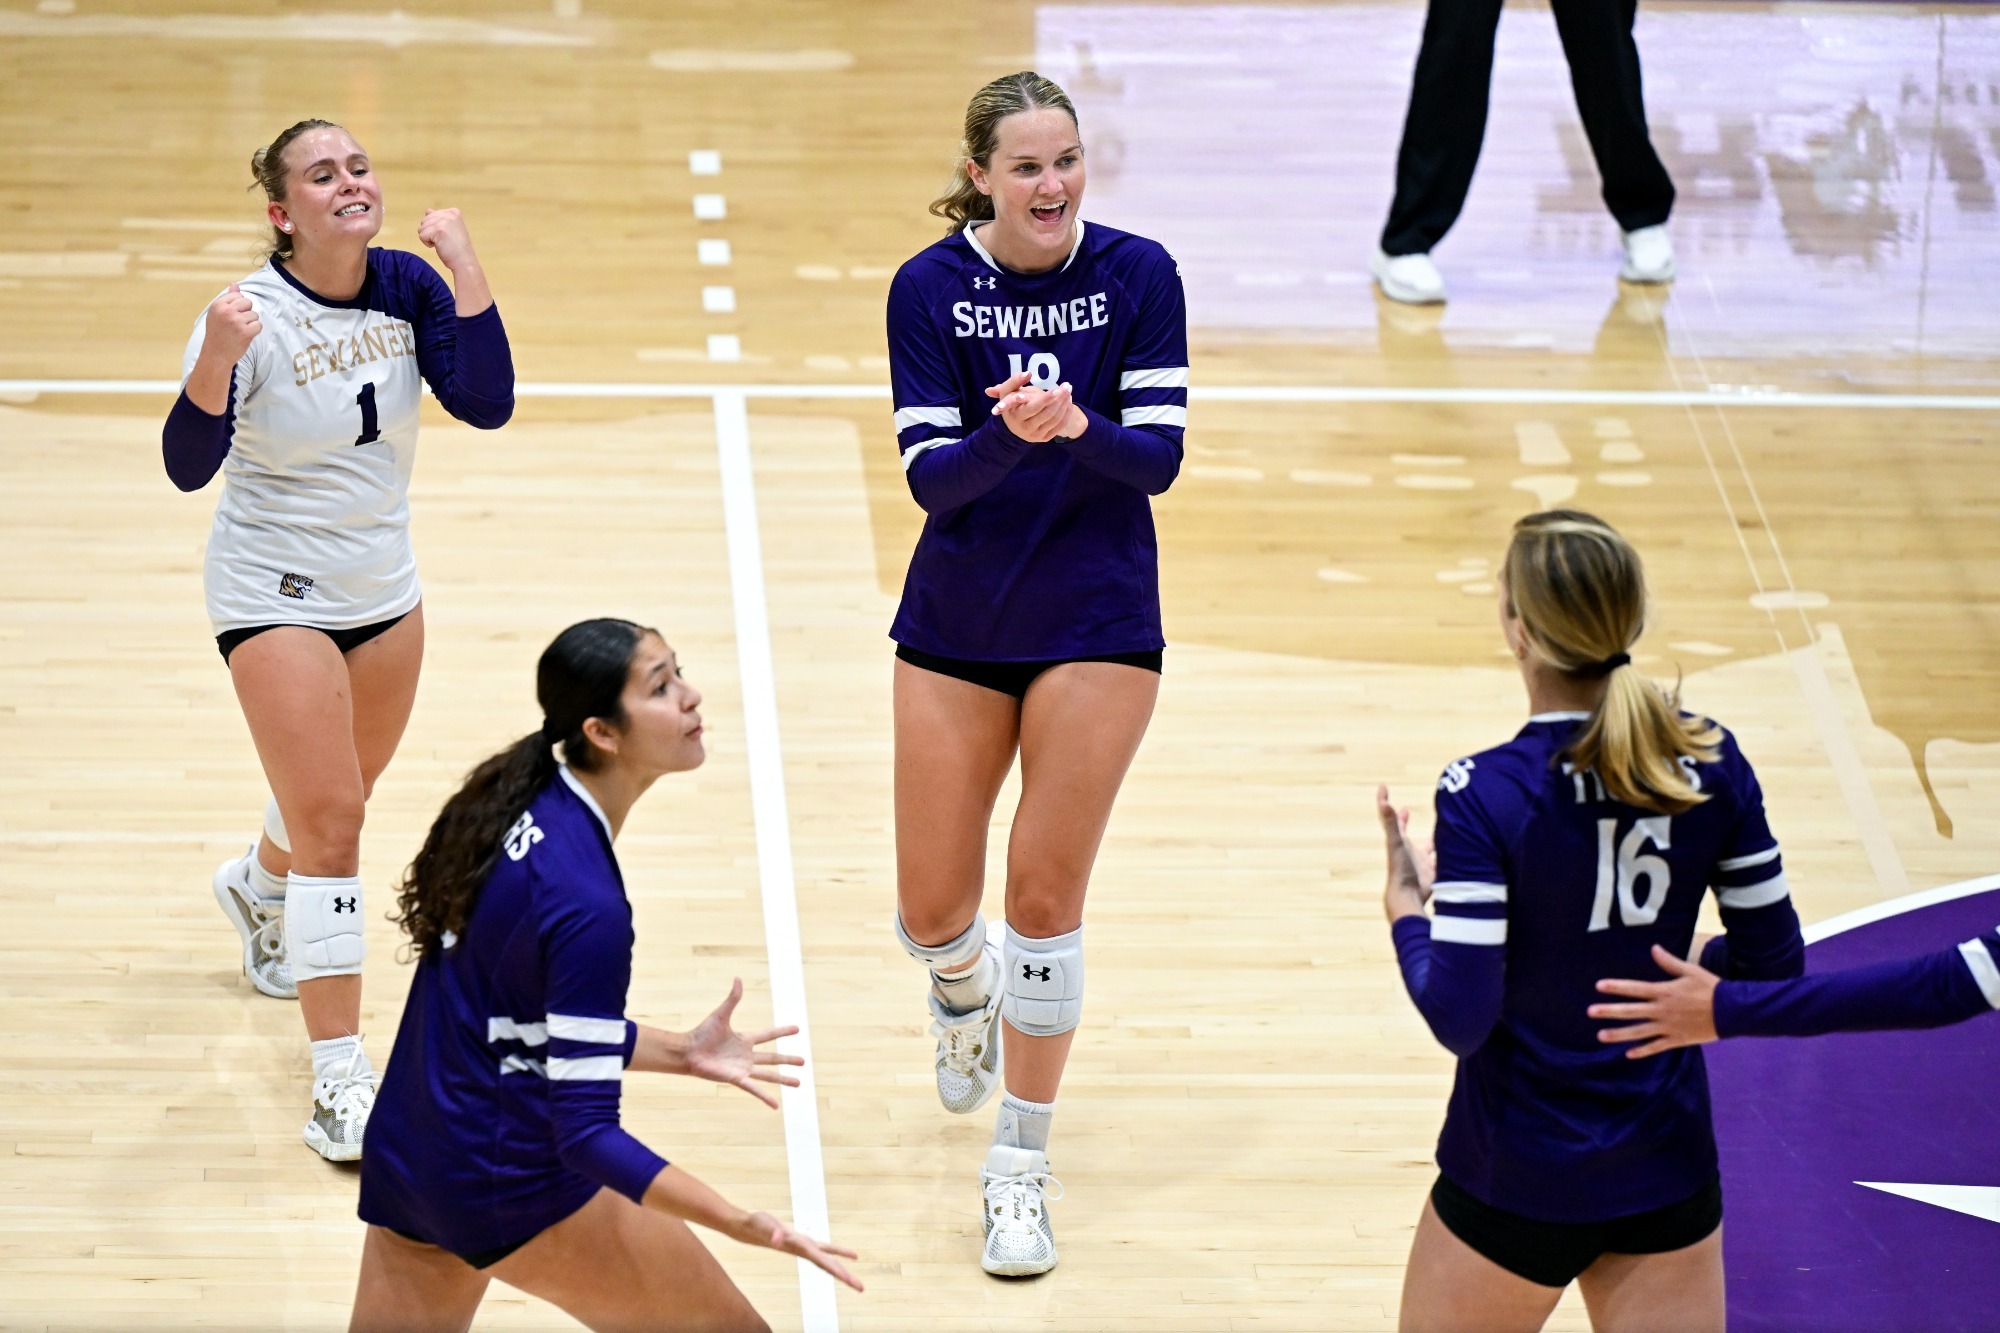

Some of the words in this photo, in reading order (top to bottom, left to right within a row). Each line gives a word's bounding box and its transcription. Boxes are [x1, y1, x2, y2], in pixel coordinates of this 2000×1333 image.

[952, 291, 1109, 338] SEWANEE
[355, 381, 381, 447] 1
[1587, 816, 1671, 932] 16
